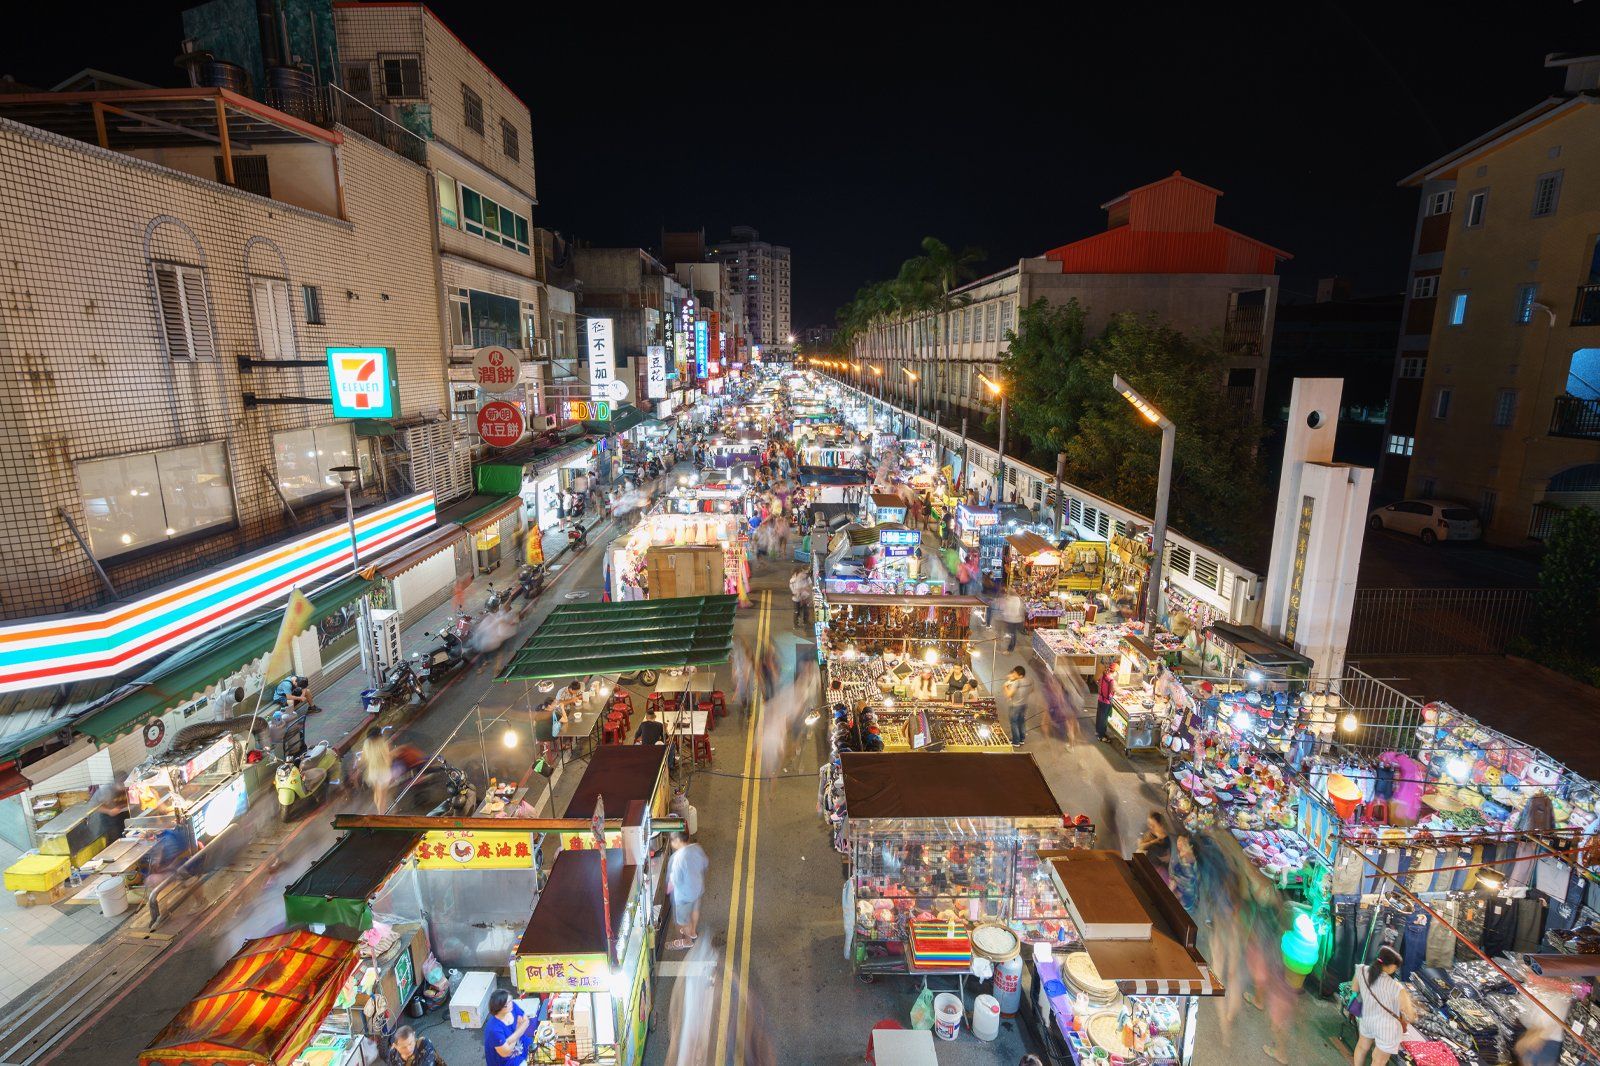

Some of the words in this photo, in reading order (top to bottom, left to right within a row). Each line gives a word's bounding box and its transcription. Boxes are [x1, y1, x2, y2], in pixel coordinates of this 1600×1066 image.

[478, 366, 514, 384] 潤餅
[651, 357, 664, 382] 豆花
[486, 408, 512, 420] 新明
[578, 401, 608, 421] DVD
[481, 423, 519, 437] 紅豆餅
[476, 841, 531, 858] 麻油雞
